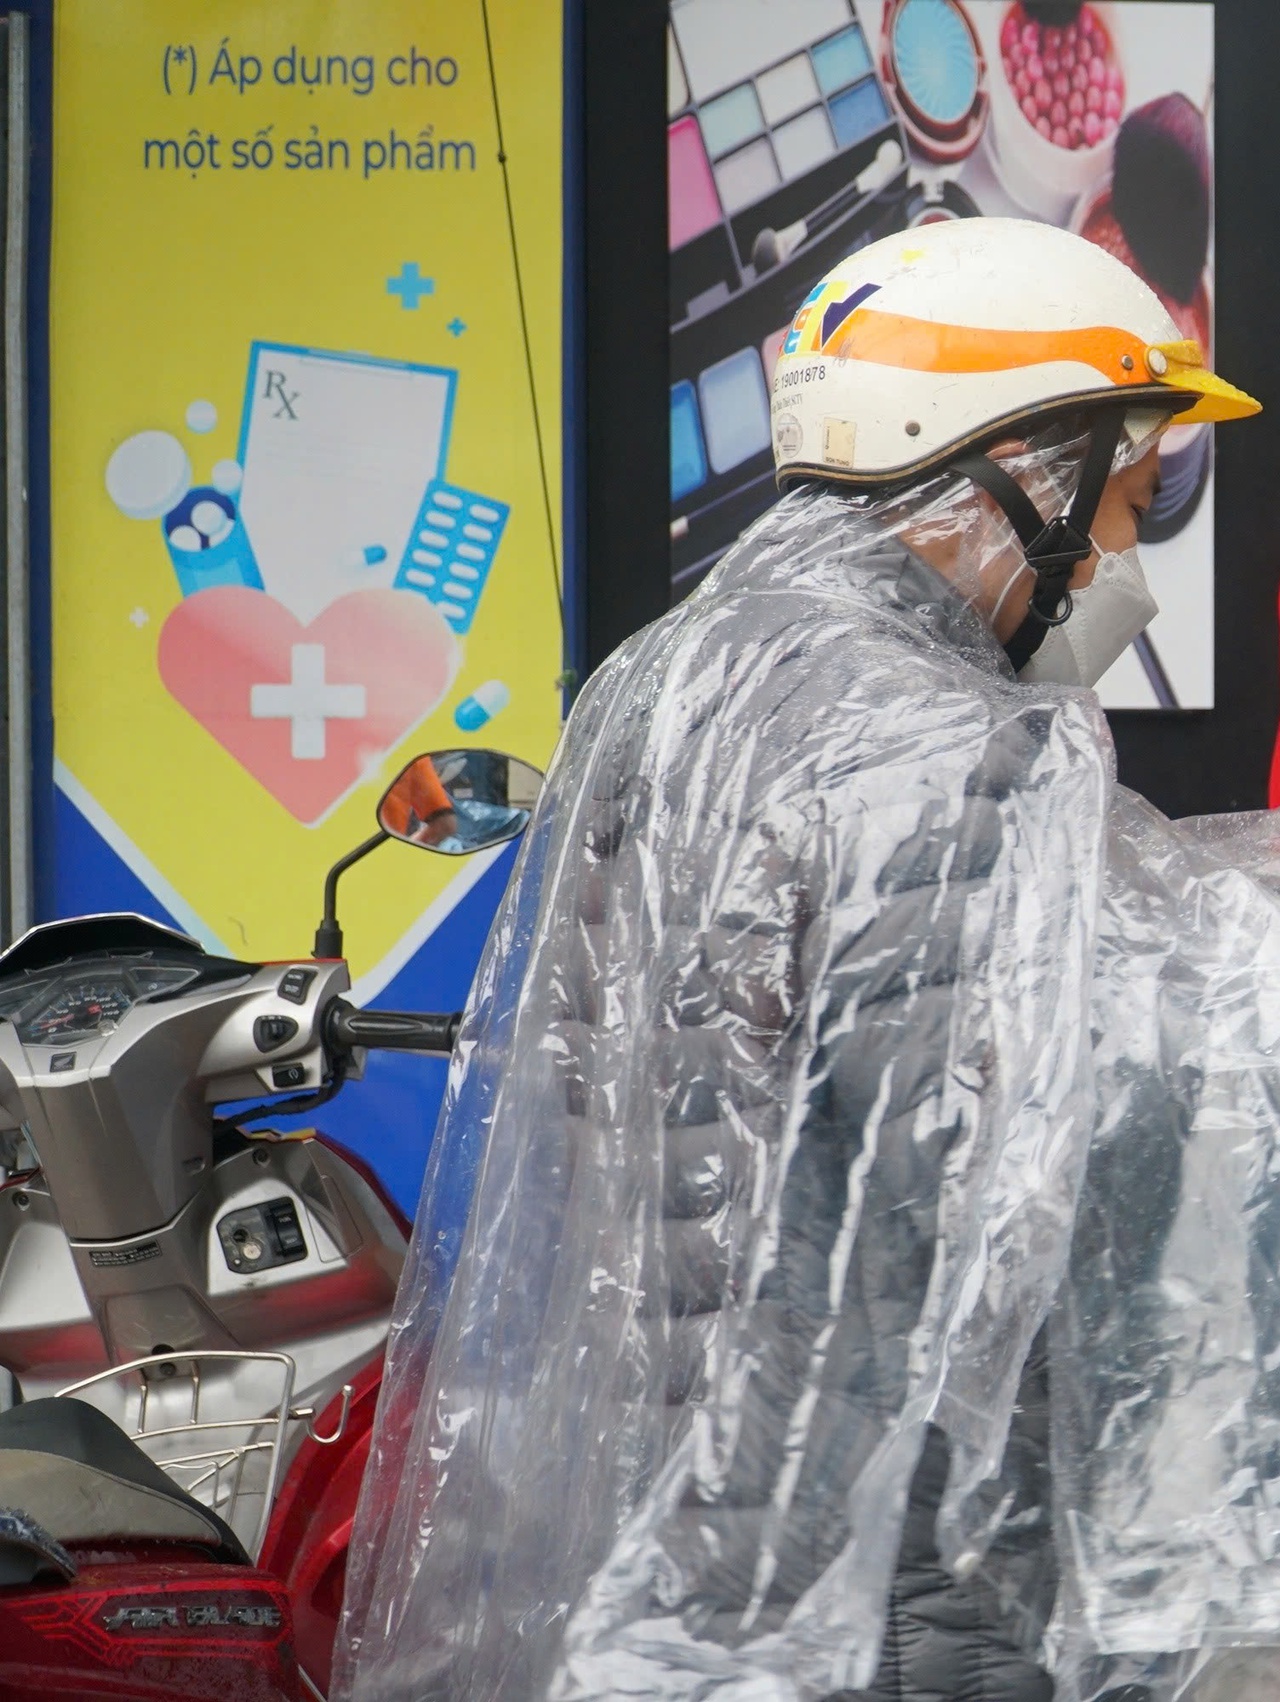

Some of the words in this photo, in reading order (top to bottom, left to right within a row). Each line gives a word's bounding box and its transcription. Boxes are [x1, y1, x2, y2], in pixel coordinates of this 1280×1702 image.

[209, 37, 262, 95] Áp
[273, 46, 374, 95] dụng
[387, 46, 459, 86] cho
[144, 128, 221, 179] một
[232, 124, 274, 170] số
[285, 125, 350, 170] sản
[363, 124, 476, 179] phẩm
[781, 365, 826, 388] 19001878
